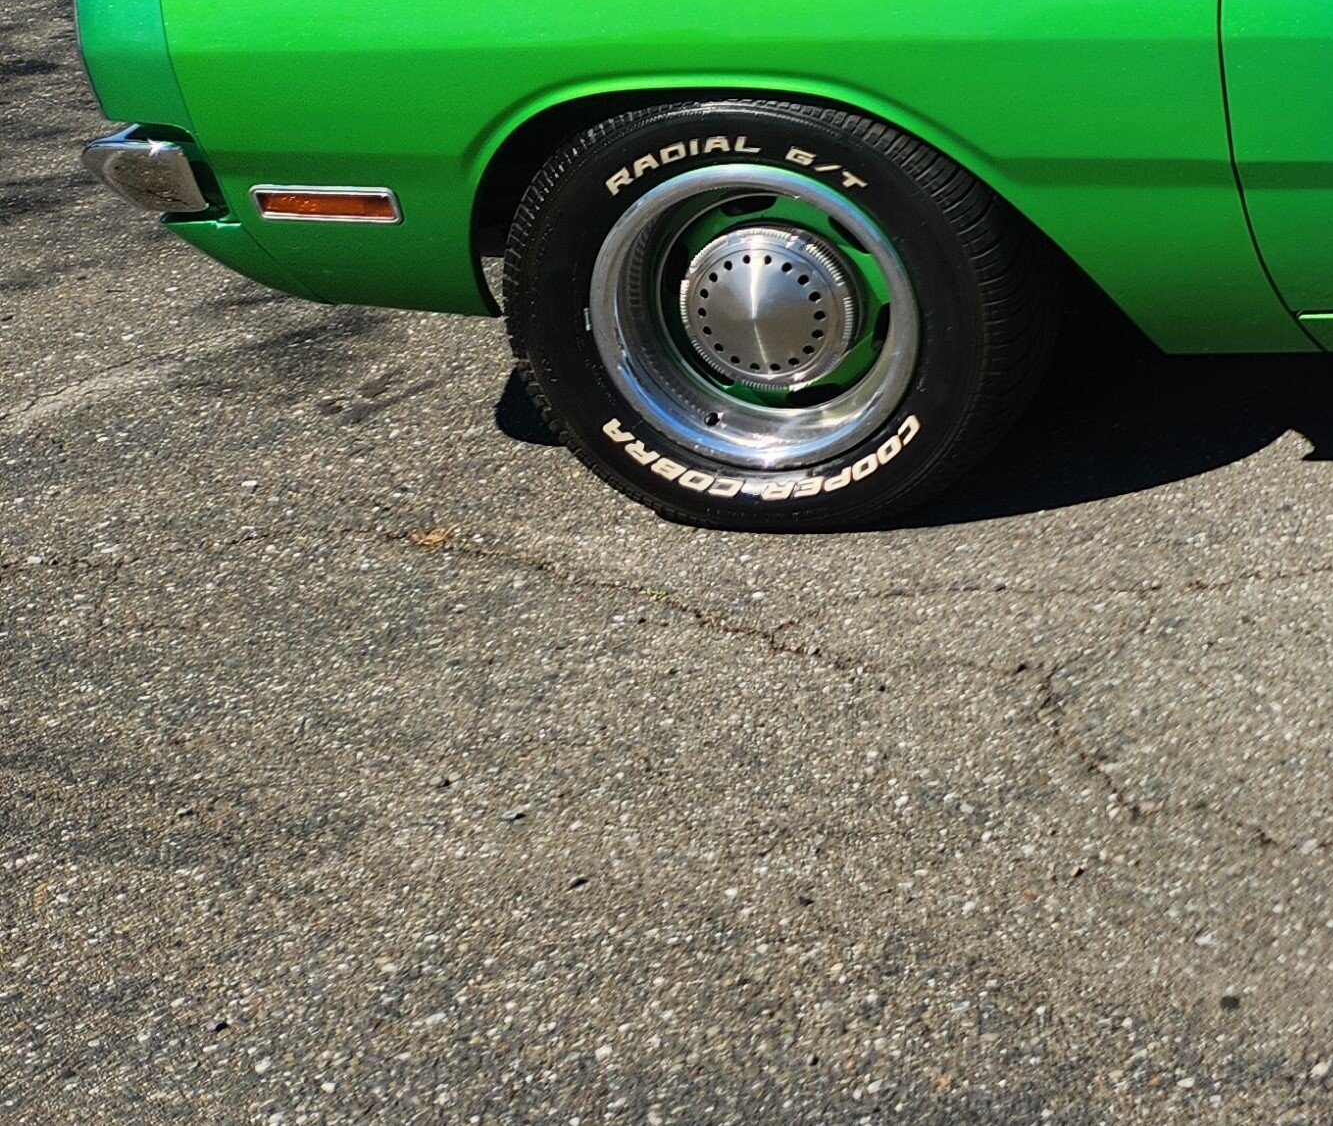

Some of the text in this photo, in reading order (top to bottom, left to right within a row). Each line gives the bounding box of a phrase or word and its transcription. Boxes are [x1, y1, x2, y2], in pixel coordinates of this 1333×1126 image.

[605, 135, 869, 196] RADIAL G/T
[602, 414, 923, 501] COOPER COBRA
